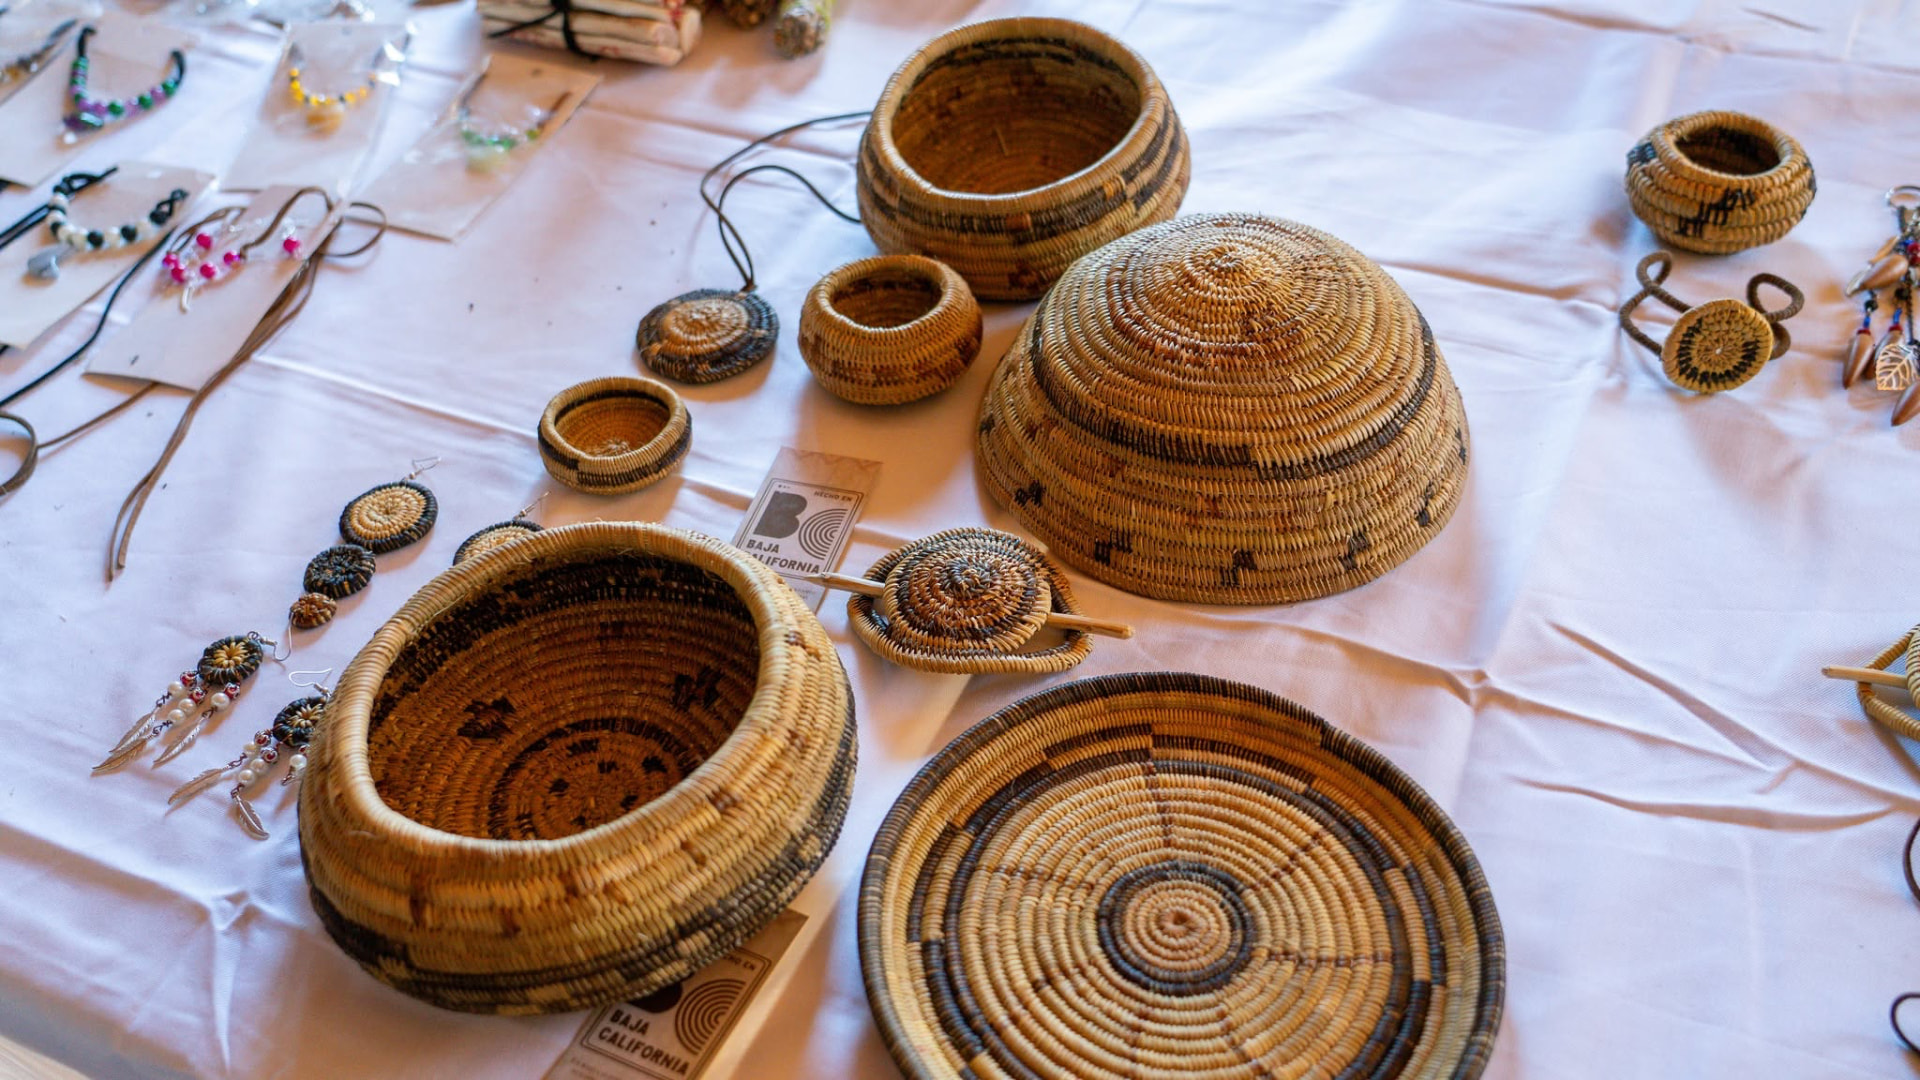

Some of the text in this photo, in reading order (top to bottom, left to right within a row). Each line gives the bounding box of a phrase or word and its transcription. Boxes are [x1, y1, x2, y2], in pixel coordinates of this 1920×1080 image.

[814, 490, 840, 500] HECHO
[746, 539, 780, 554] BAJA
[746, 551, 820, 574] ALIFORNIA
[743, 961, 755, 971] EN
[610, 1009, 651, 1036] BAJA
[598, 1027, 690, 1076] CALIFORNIA
